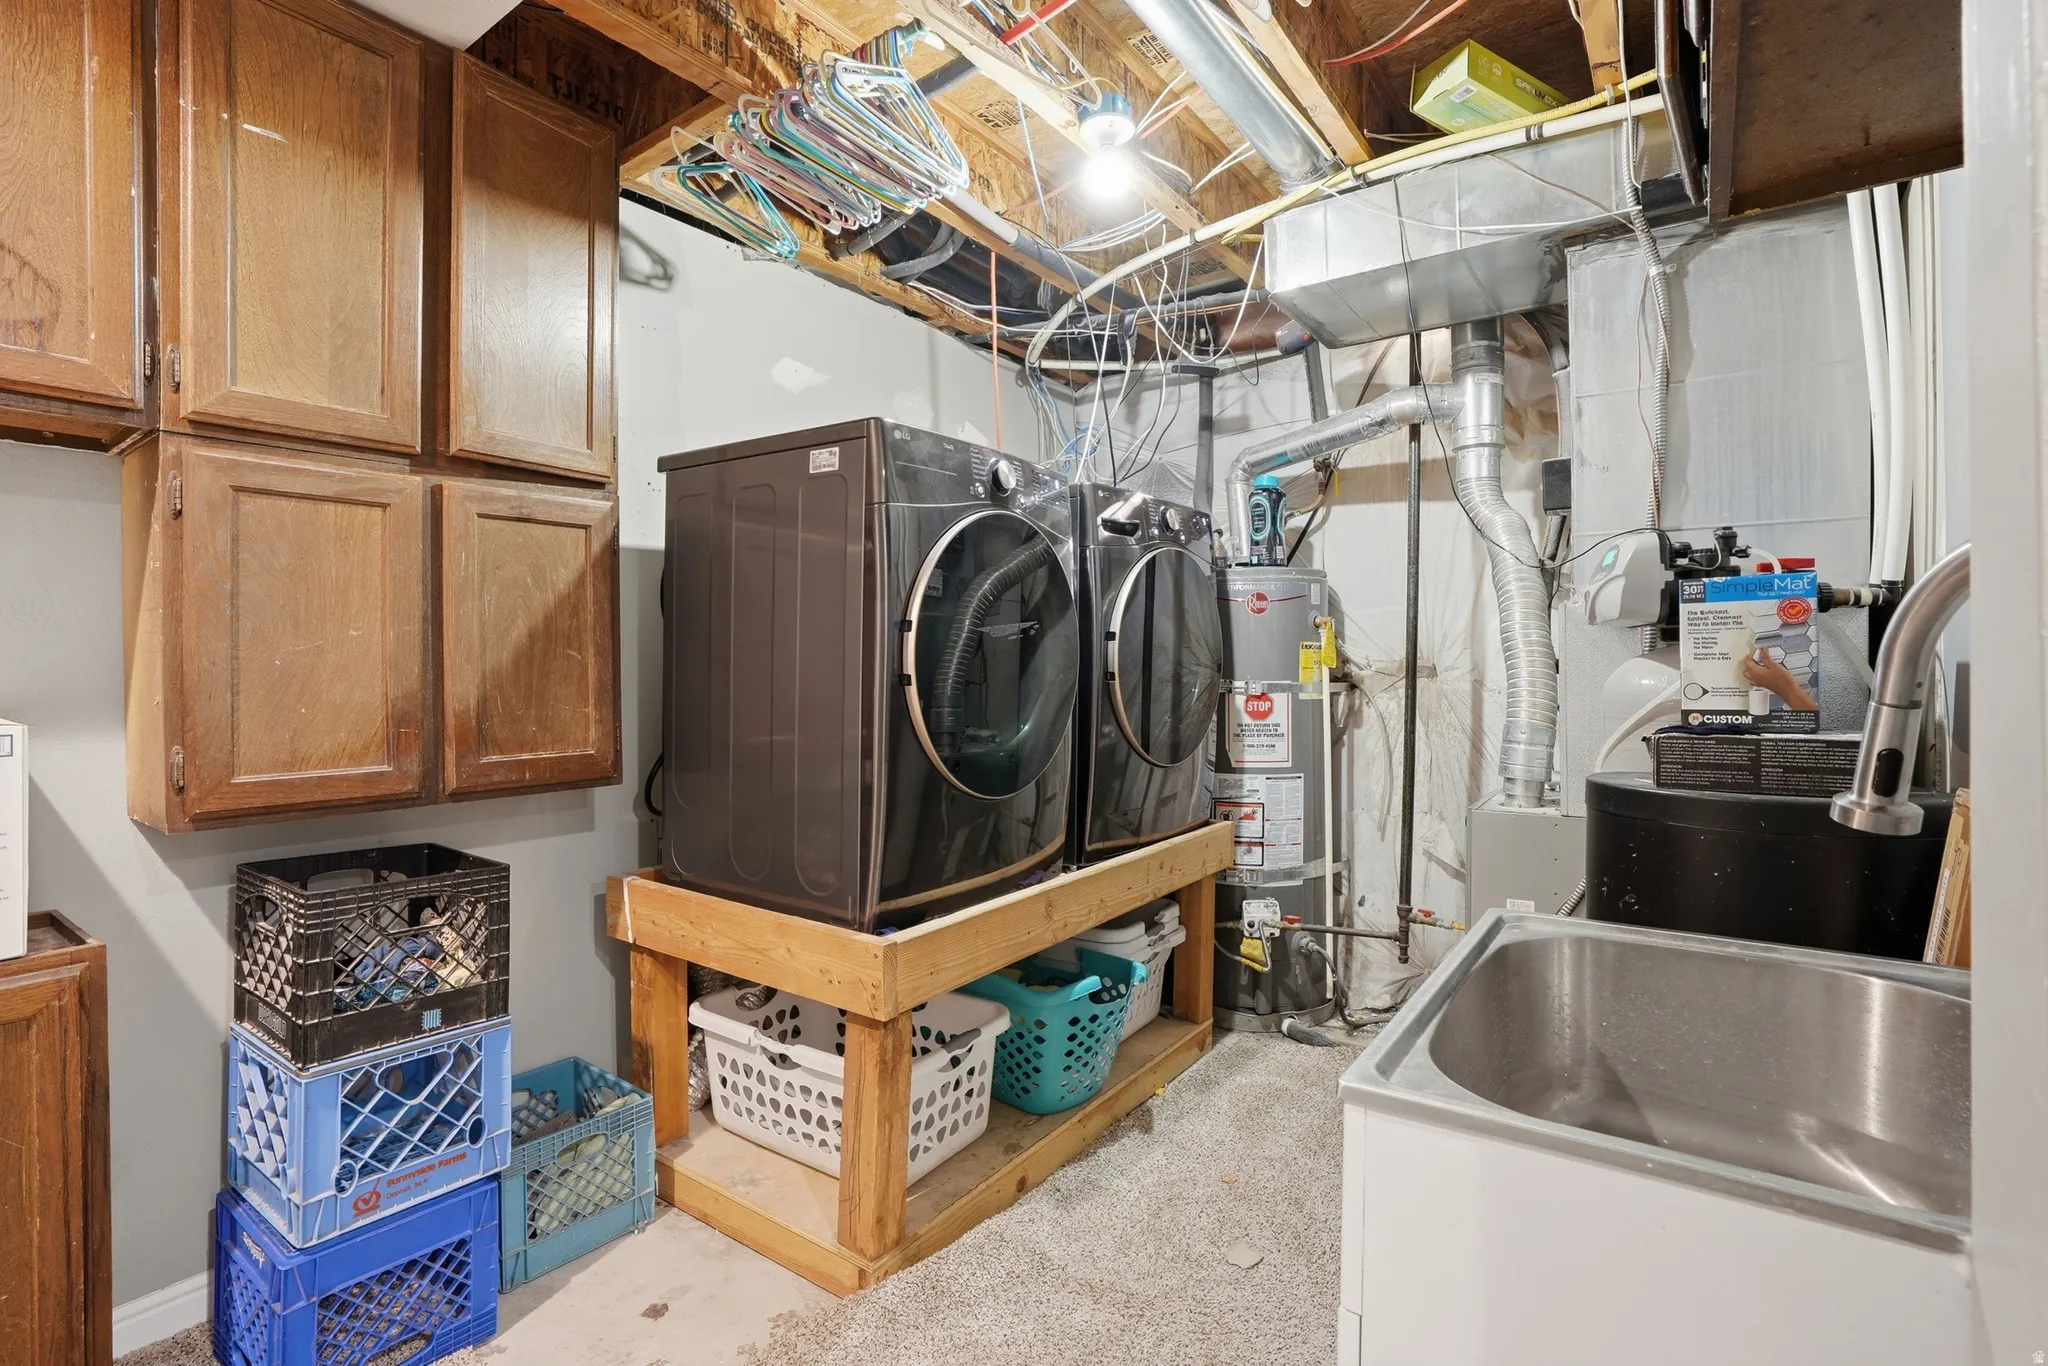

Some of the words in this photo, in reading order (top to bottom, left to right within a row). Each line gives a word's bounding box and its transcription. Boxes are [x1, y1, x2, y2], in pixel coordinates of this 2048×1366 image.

[586, 92, 624, 126] 210
[1710, 577, 1812, 594] SimpleMat
[1246, 700, 1272, 712] STOP
[1703, 715, 1753, 724] CUSTOM
